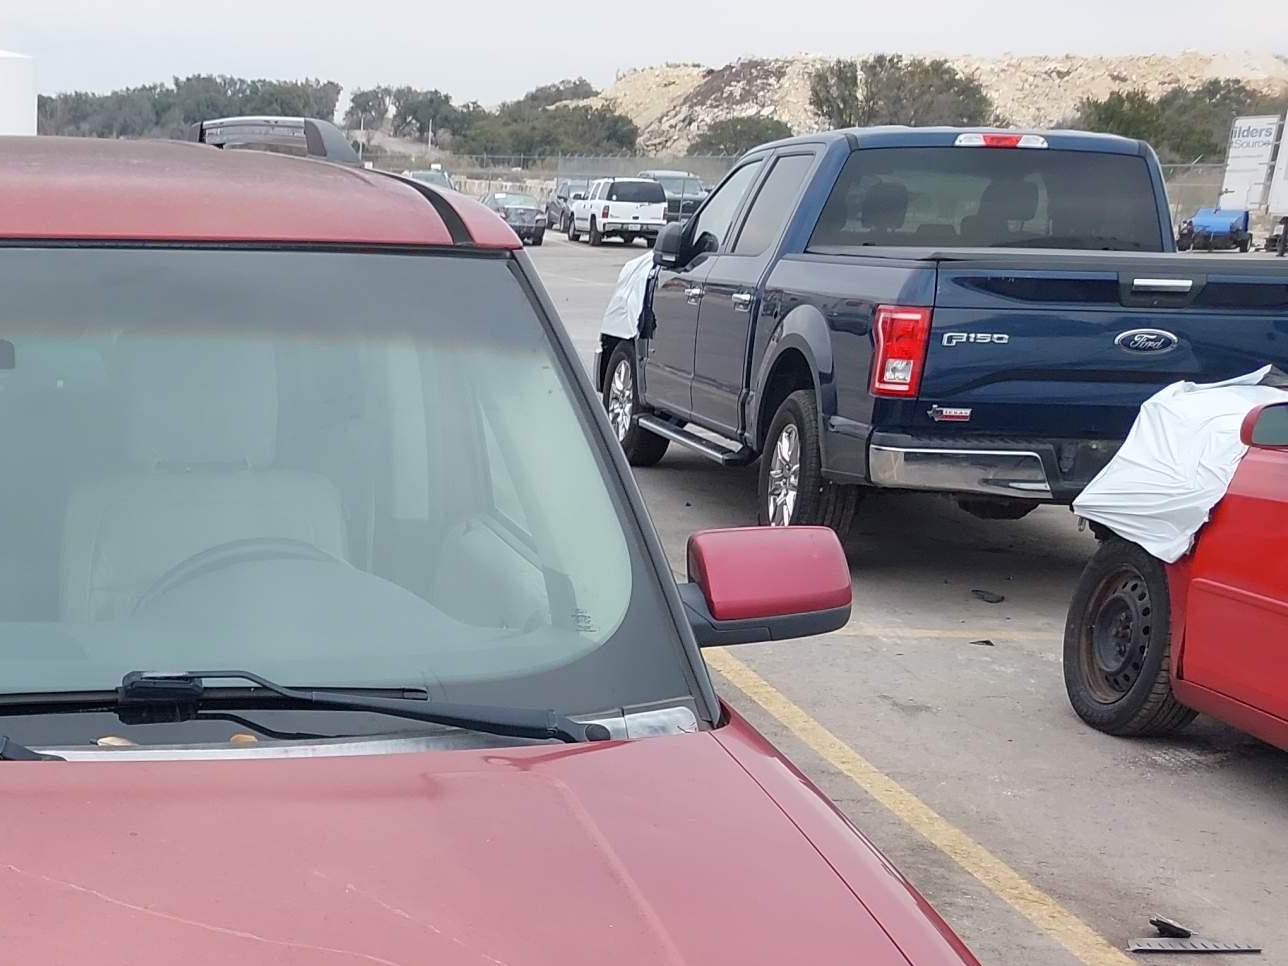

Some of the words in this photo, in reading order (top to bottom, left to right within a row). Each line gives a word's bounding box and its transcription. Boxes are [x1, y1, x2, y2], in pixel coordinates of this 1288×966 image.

[1231, 125, 1273, 139] ilders
[941, 332, 1010, 346] F150
[1129, 334, 1165, 349] Ford
